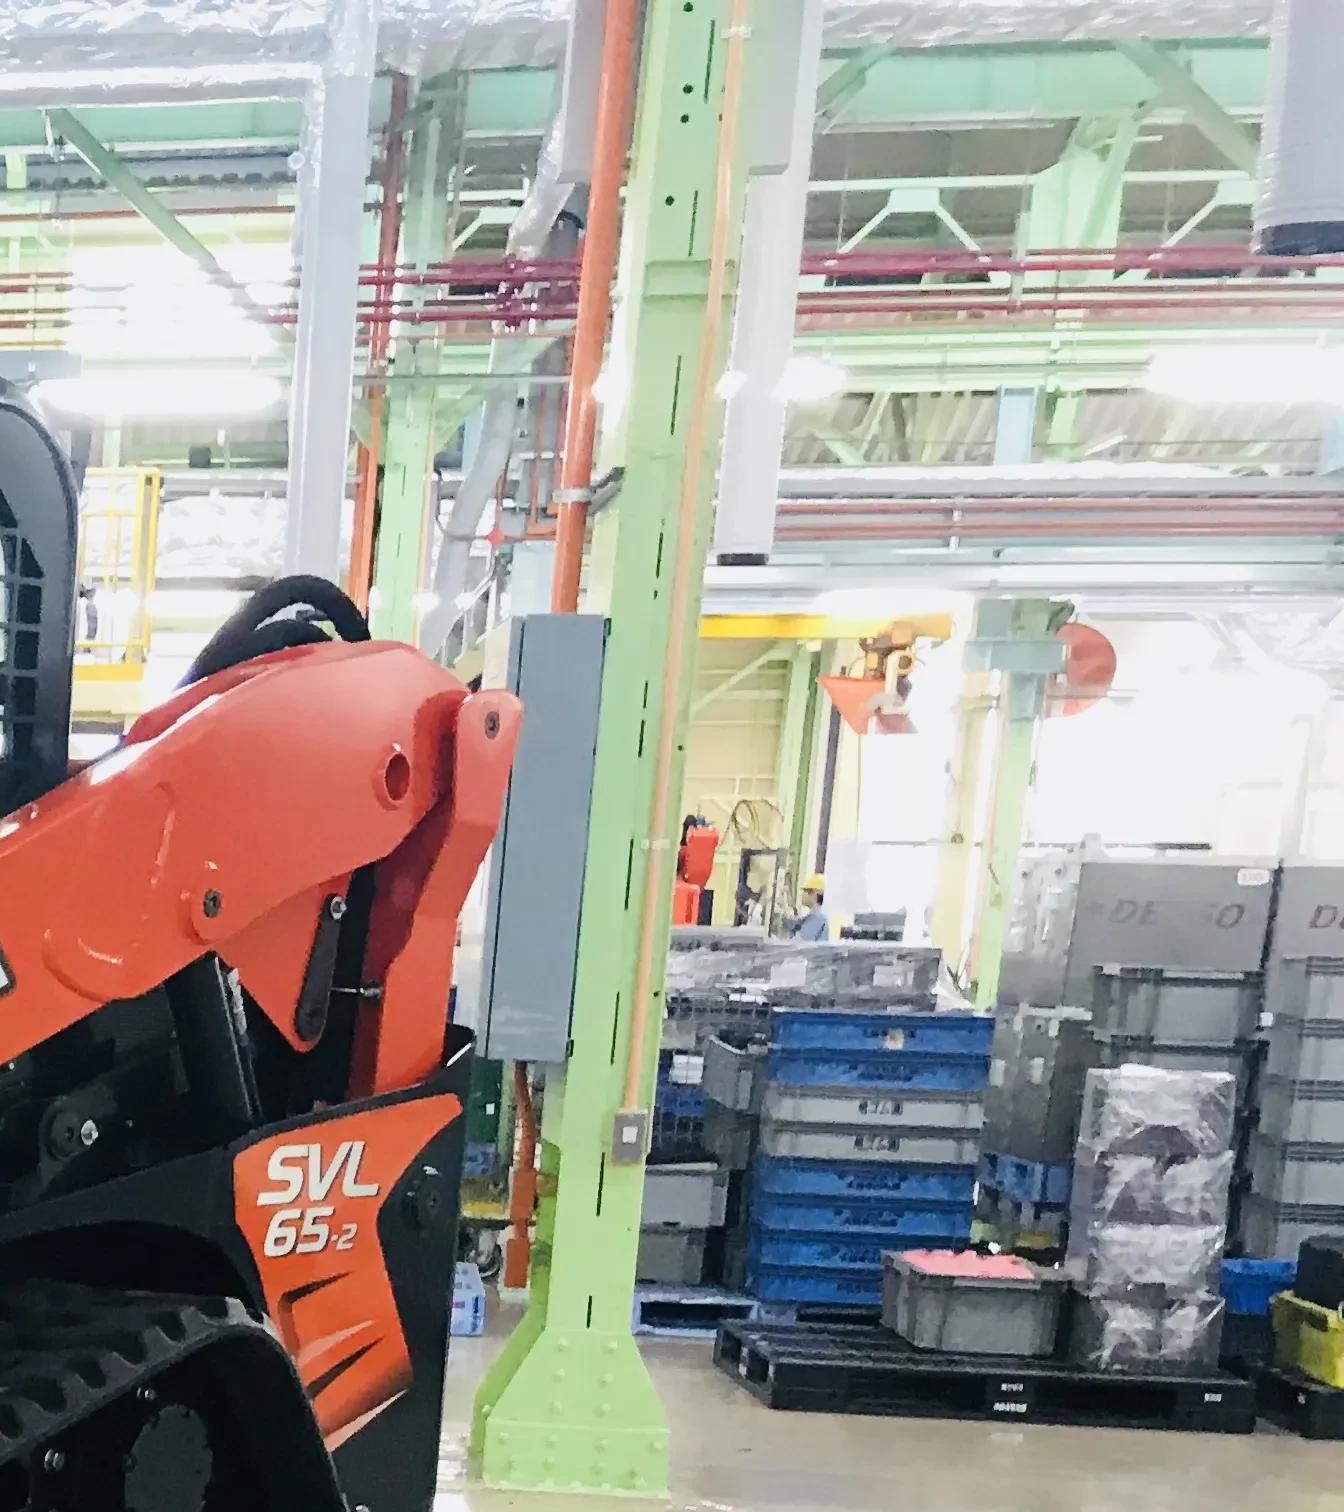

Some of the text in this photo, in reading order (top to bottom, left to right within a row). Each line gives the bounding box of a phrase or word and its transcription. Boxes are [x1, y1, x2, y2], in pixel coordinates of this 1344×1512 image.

[1109, 899, 1246, 929] DEO
[256, 1140, 380, 1206] SVL
[263, 1205, 358, 1258] 65-2
